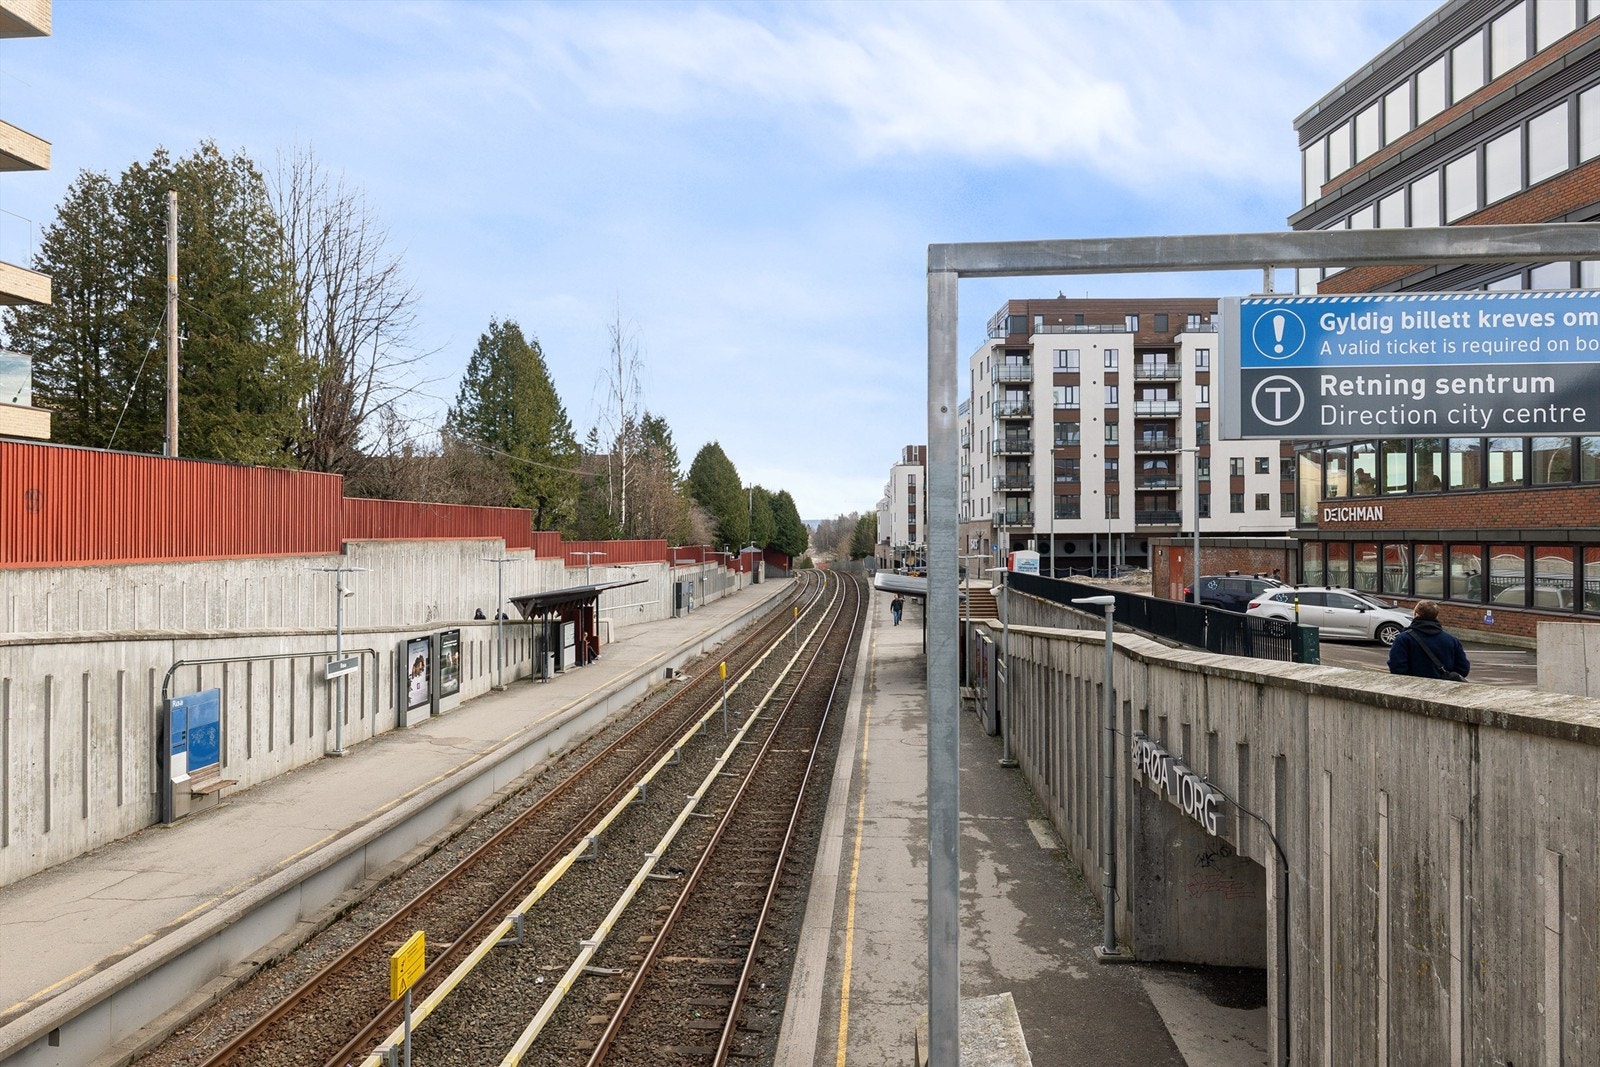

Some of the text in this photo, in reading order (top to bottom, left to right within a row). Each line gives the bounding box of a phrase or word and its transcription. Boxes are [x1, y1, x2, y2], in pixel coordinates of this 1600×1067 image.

[1319, 310, 1599, 335] Gyldig billett kreves om
[1320, 340, 1332, 355] A
[1338, 340, 1380, 355] valid
[1386, 339, 1437, 354] ticket
[1443, 338, 1457, 353] is
[1462, 337, 1540, 356] required
[1547, 339, 1569, 352] on
[1320, 374, 1556, 400] Retning sentrum
[1265, 387, 1291, 419] T
[1321, 403, 1587, 429] Direction city centre
[1323, 506, 1384, 522] DEICHMAN
[1142, 741, 1220, 837] RØA TORG
